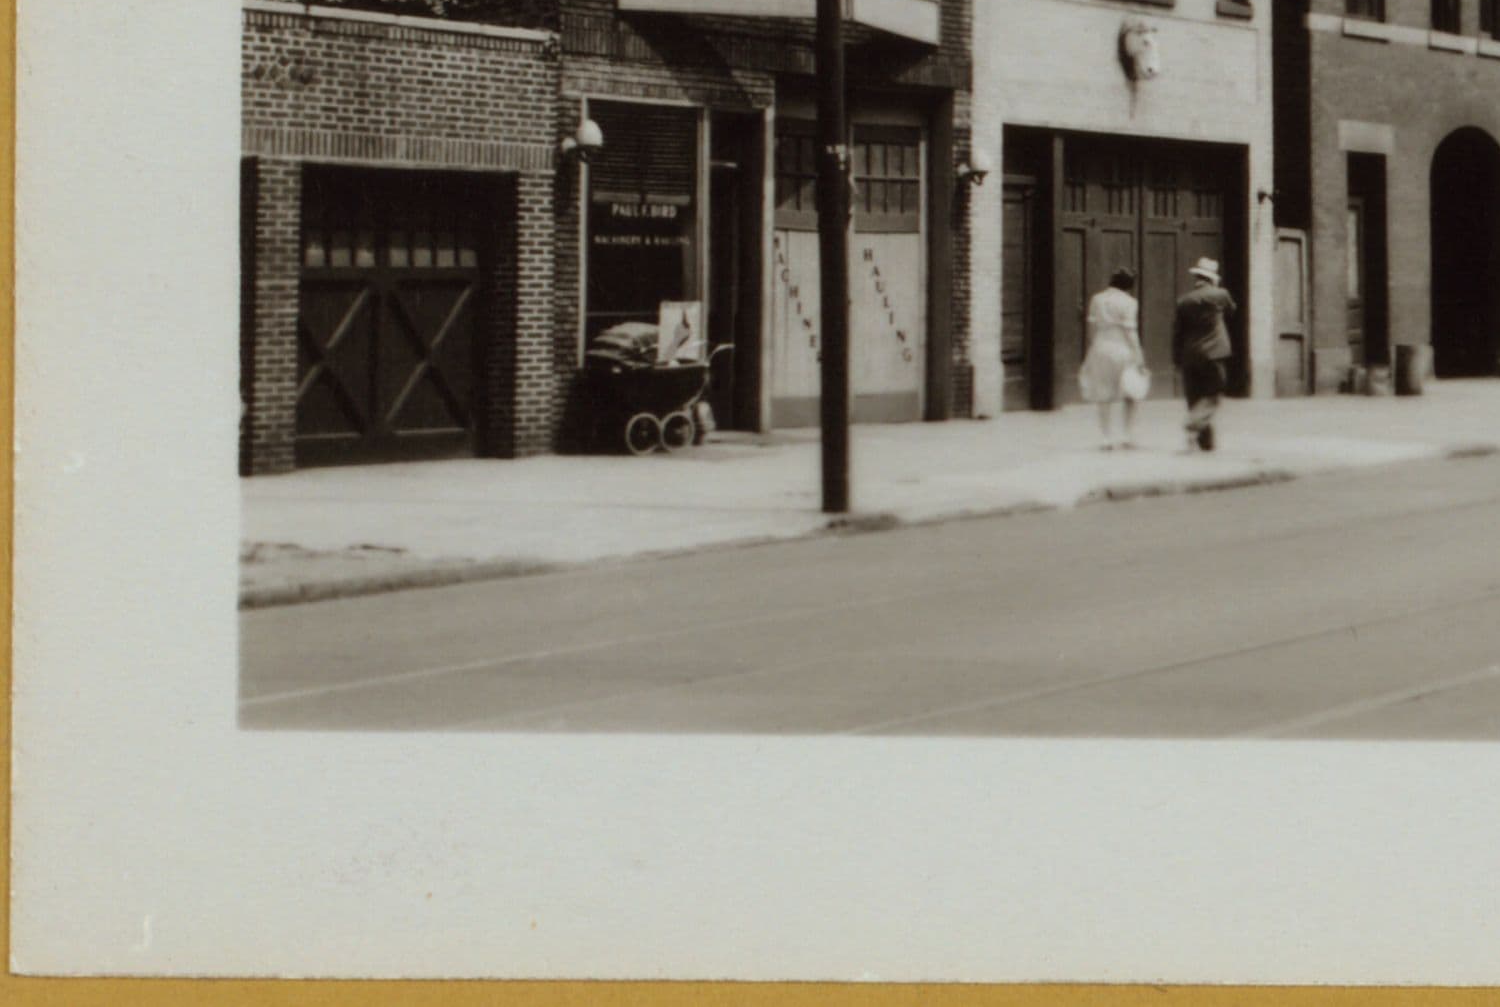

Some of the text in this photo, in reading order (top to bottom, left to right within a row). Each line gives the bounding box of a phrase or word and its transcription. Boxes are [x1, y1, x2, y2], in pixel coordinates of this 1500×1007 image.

[611, 203, 639, 217] PAUL
[651, 204, 677, 218] BIRD
[593, 235, 641, 245] MACHINERY
[644, 236, 652, 246] &
[863, 247, 913, 362] HAULING
